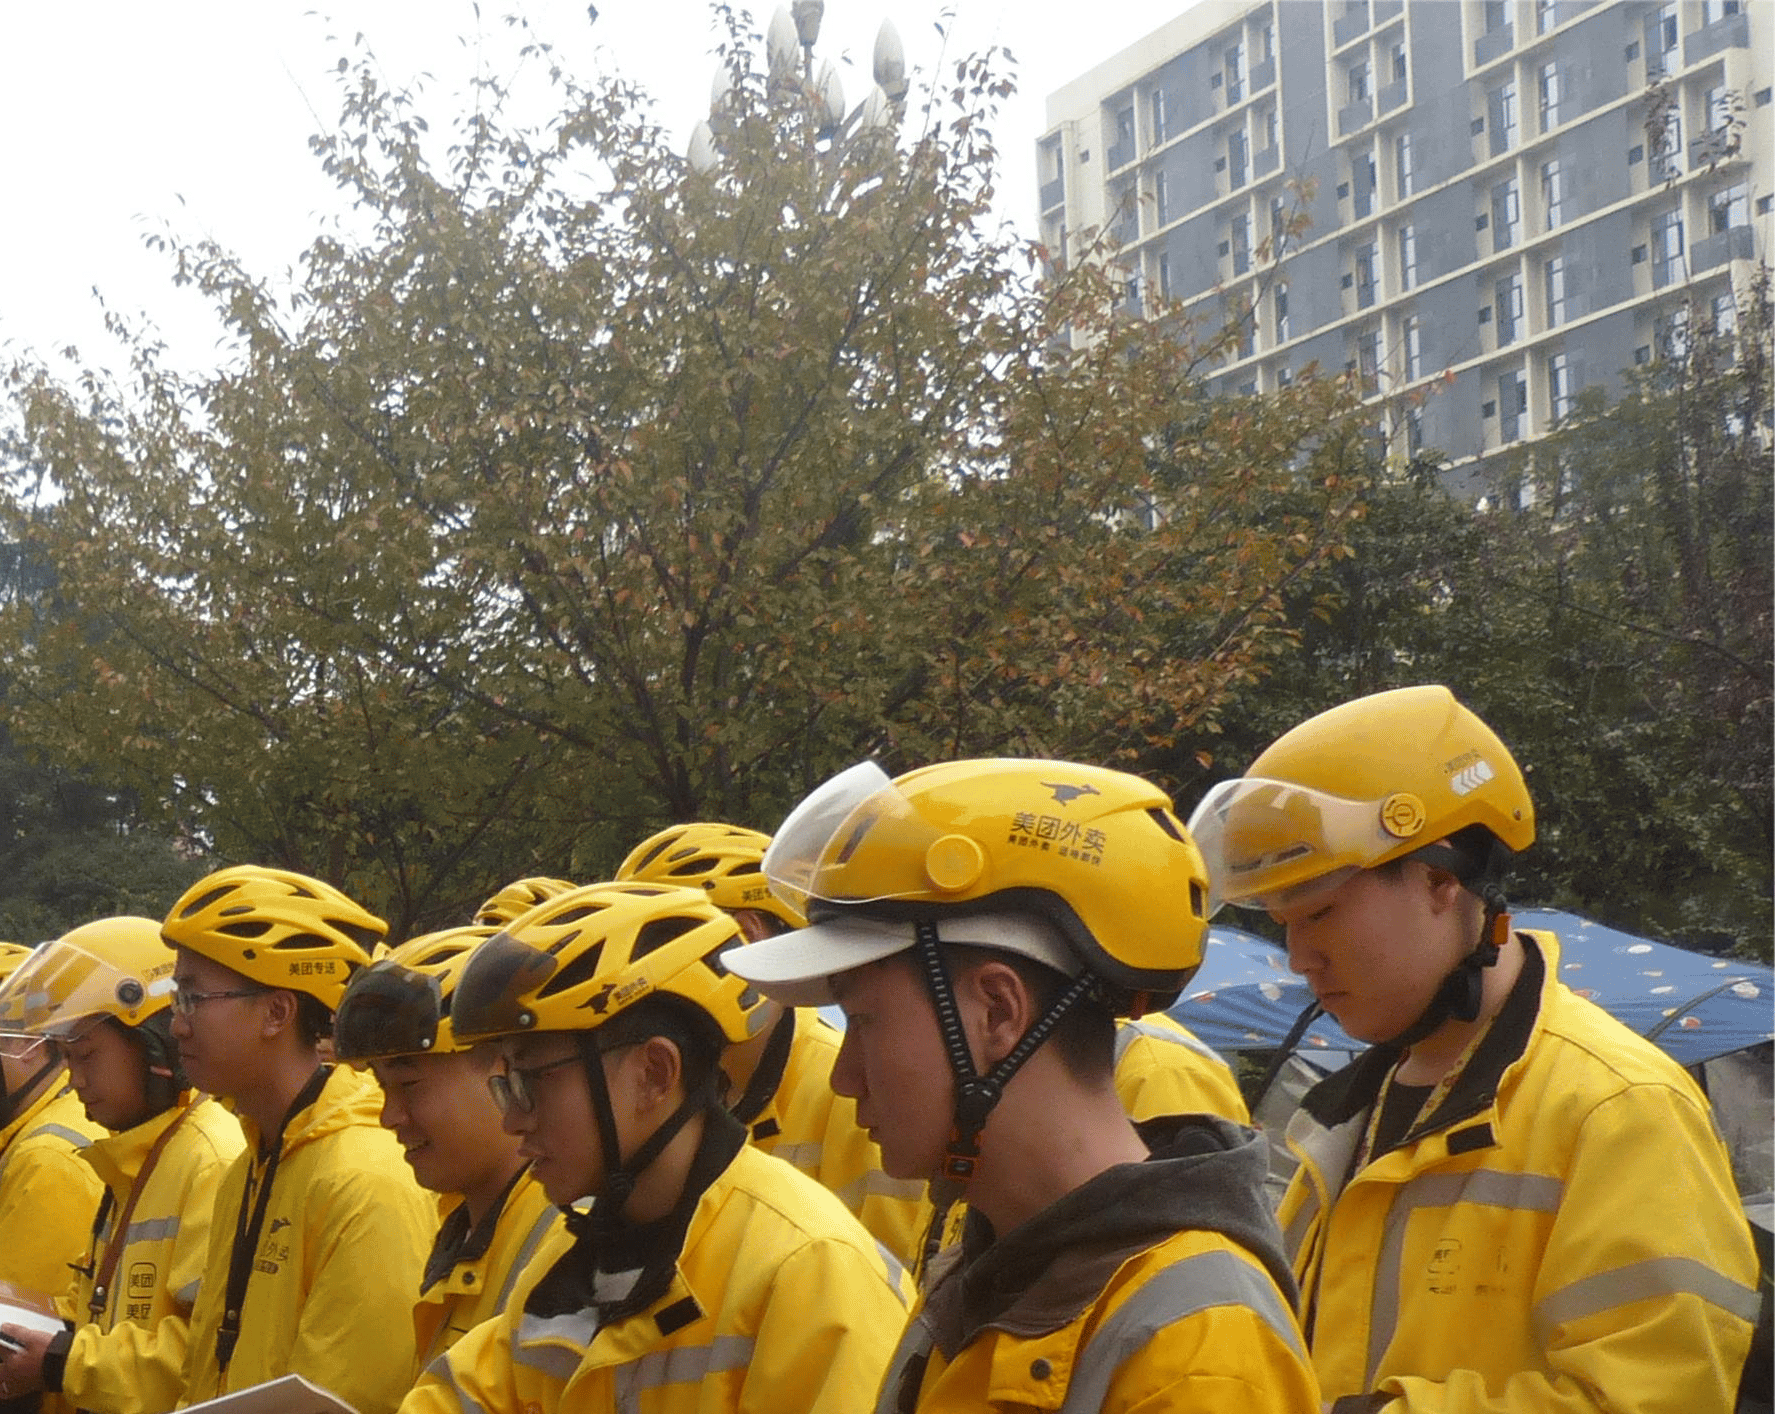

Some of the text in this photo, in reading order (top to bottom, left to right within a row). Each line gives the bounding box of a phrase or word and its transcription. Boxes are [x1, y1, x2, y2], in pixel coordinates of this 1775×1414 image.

[1010, 811, 1107, 854] 美团外卖
[130, 1273, 154, 1288] 美团
